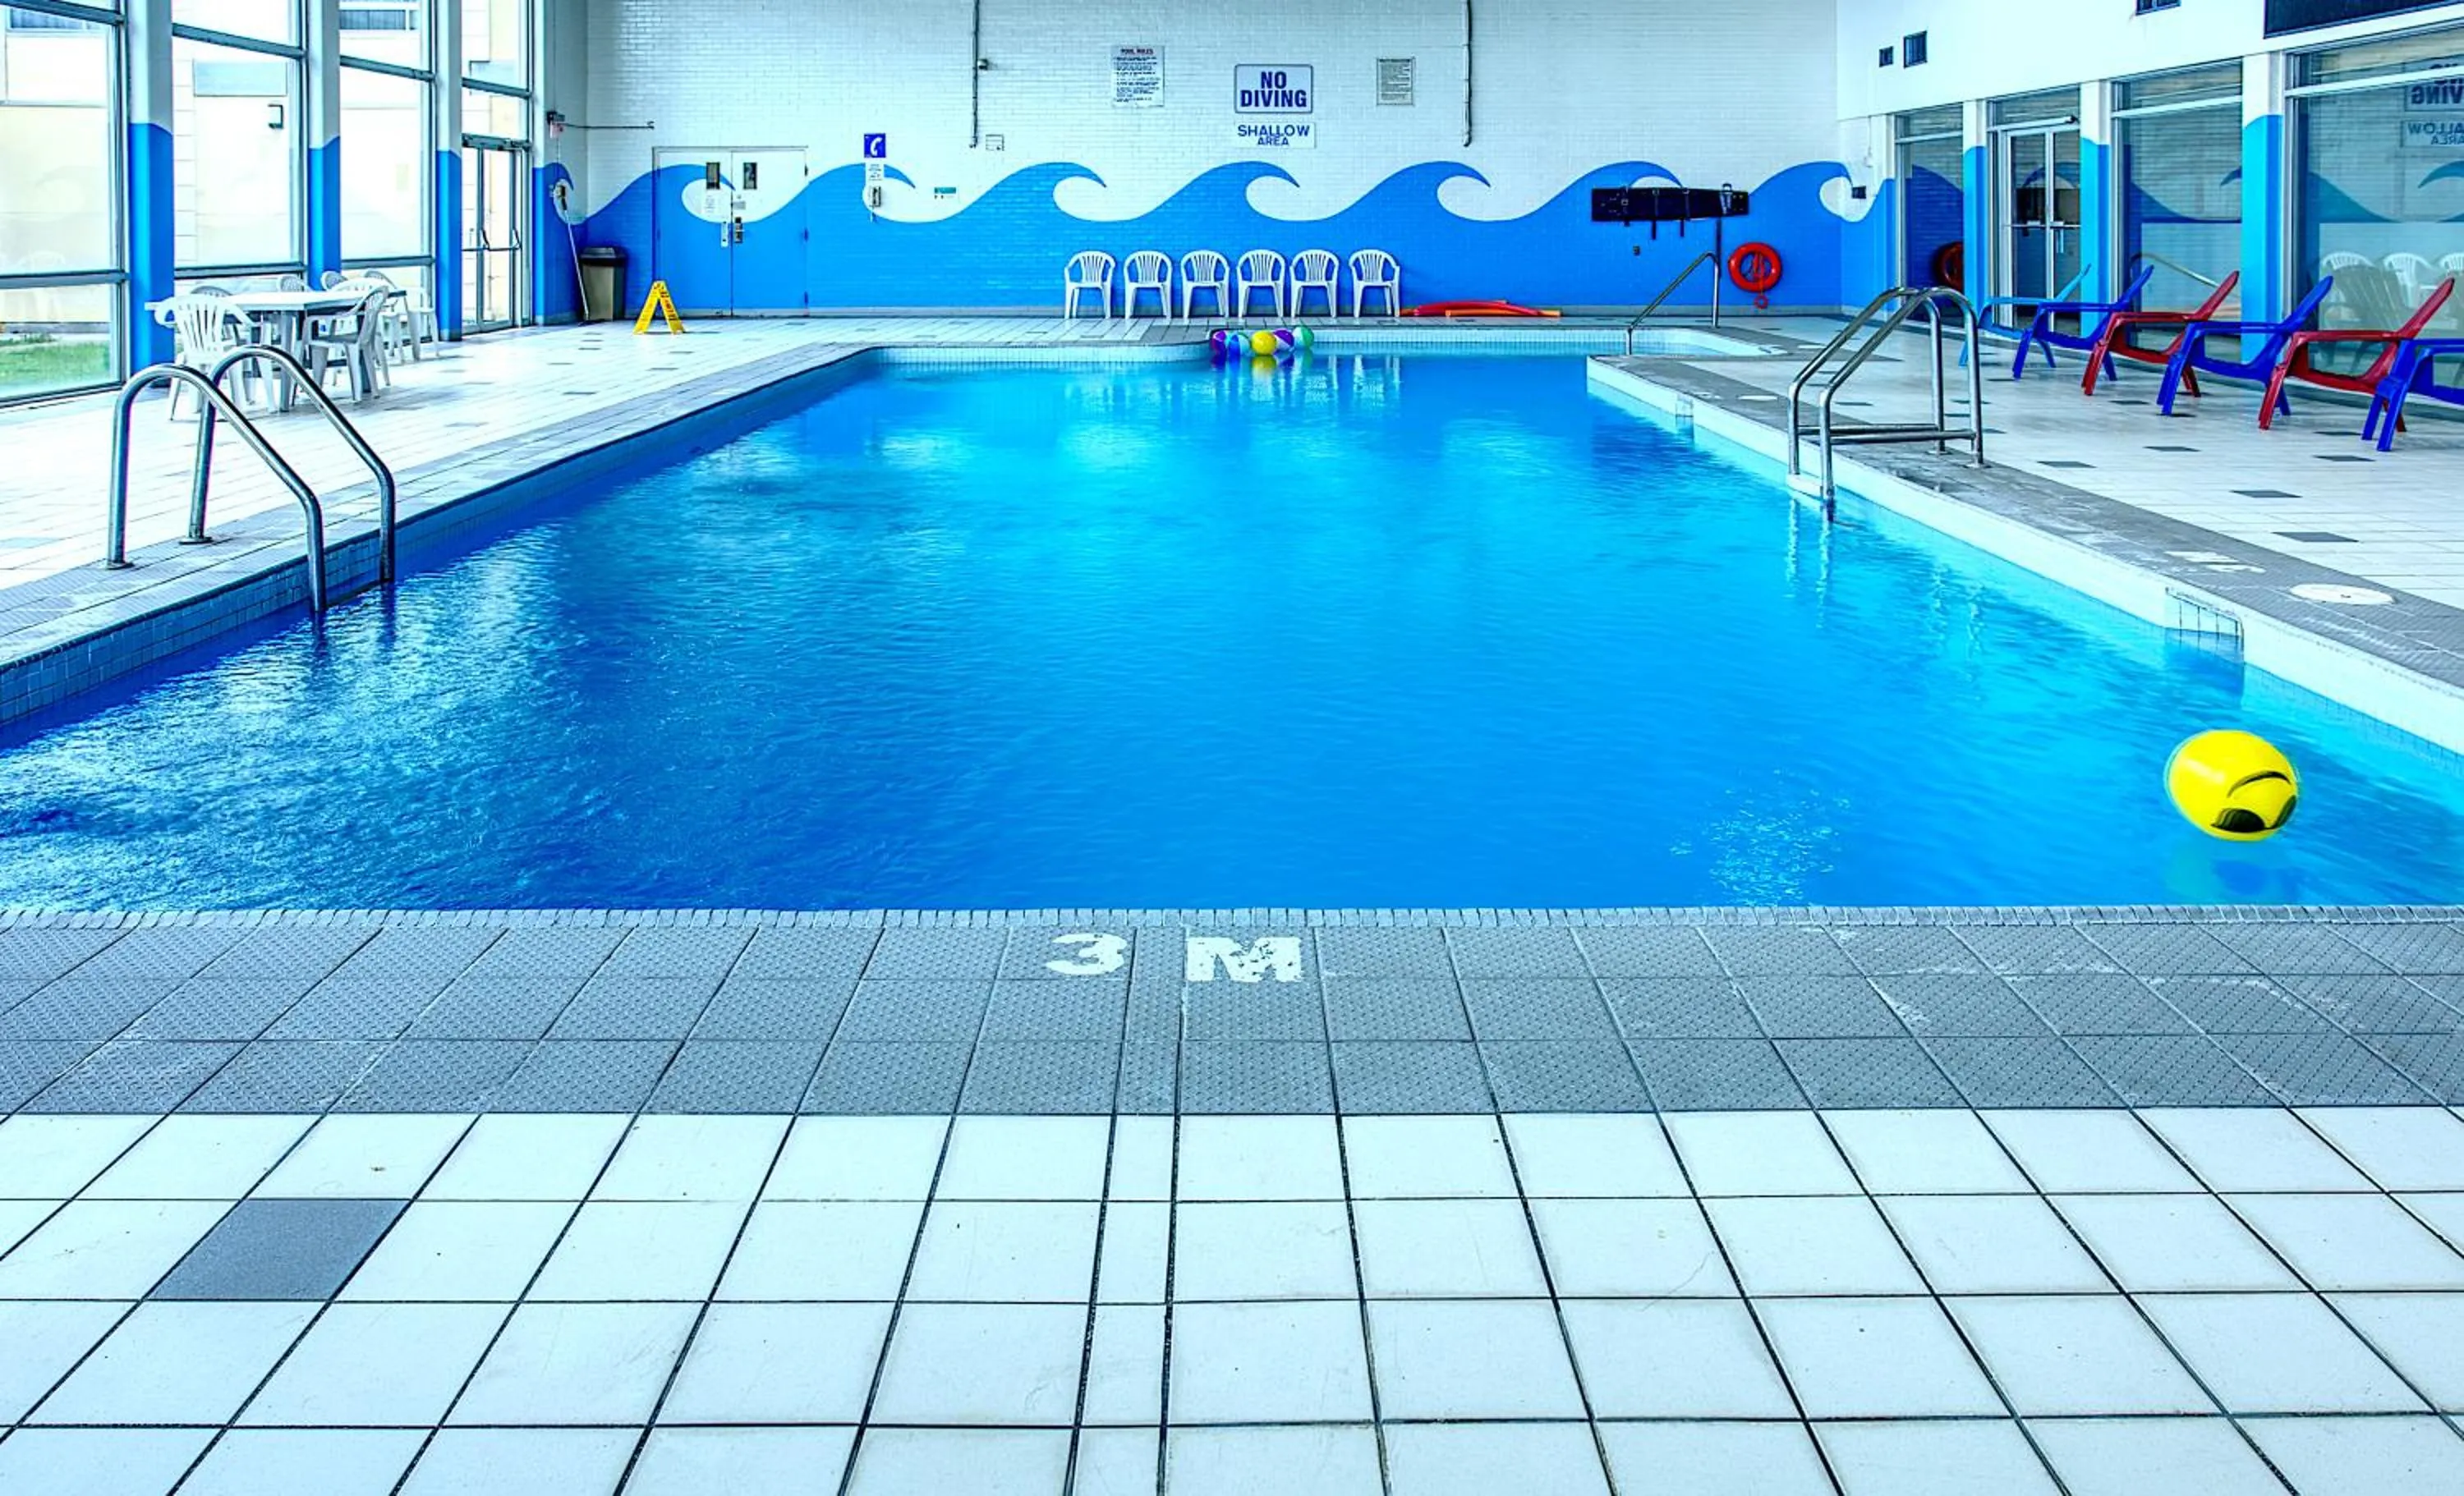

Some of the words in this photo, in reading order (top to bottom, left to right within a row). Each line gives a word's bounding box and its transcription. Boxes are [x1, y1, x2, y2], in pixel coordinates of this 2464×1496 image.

[1261, 71, 1287, 89] NO
[1240, 89, 1308, 108] DIVING
[1238, 124, 1310, 137] SHALLOW
[1257, 136, 1289, 146] AREA
[1046, 933, 1129, 975] 3
[1187, 936, 1302, 983] M
